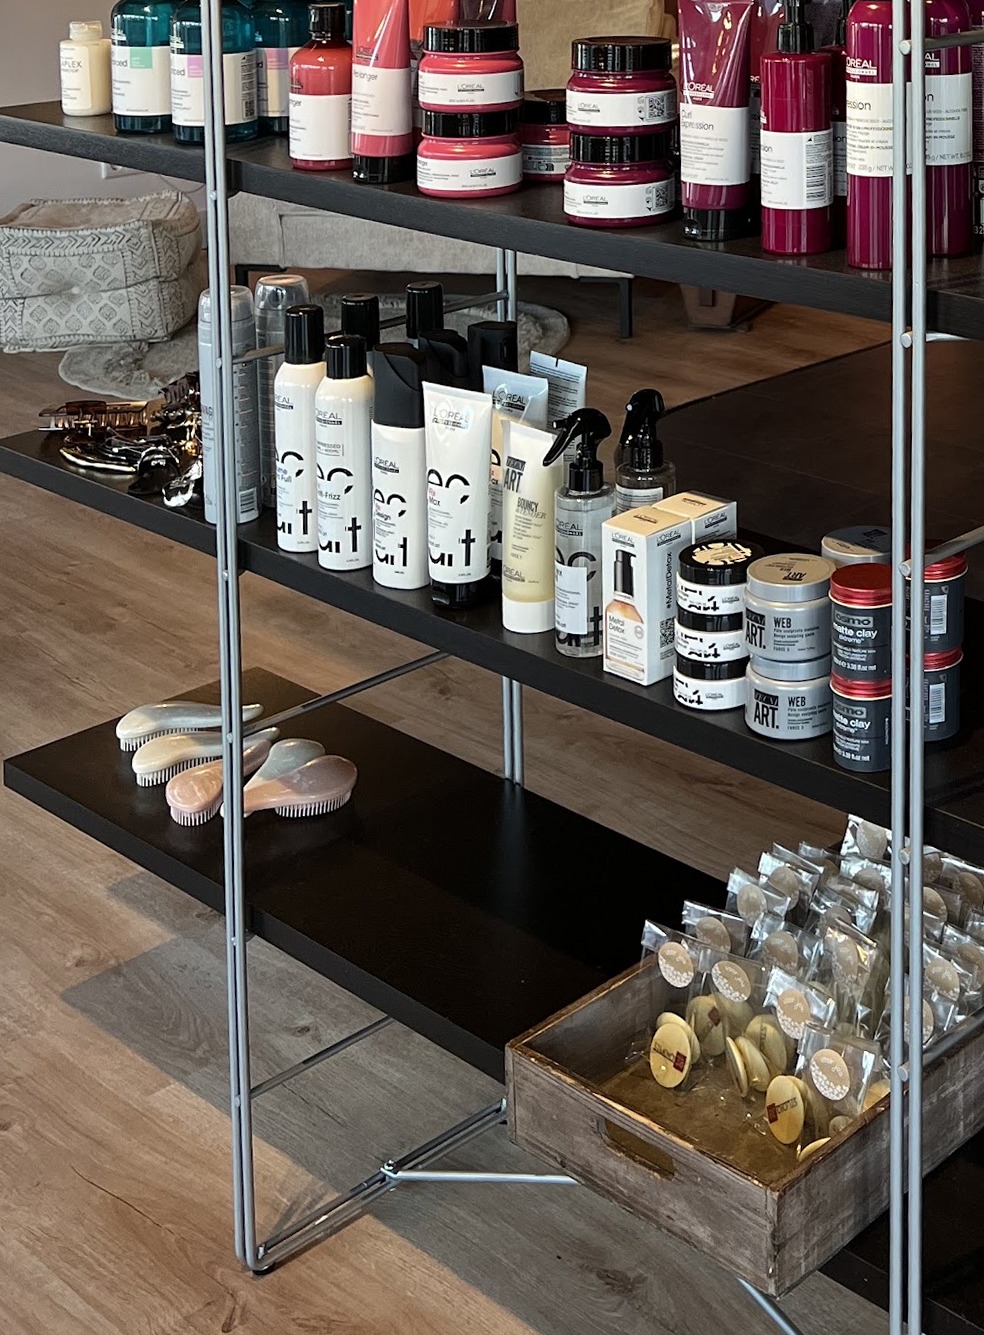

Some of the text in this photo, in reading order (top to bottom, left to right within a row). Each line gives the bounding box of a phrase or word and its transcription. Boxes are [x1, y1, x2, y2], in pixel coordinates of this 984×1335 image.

[493, 391, 525, 405] L'ORÉAL
[429, 497, 441, 507] Max
[517, 496, 539, 512] BOUNCY
[657, 529, 680, 543] L'ORÉAL
[665, 551, 673, 609] #MetalDetox
[774, 617, 792, 629] WEB
[835, 613, 872, 626] osmo
[608, 623, 625, 634] Detox
[745, 621, 766, 650] ART.
[832, 622, 878, 640] matte clay
[787, 696, 806, 708] WEB
[753, 702, 780, 729] ART.
[849, 719, 871, 730] clay
